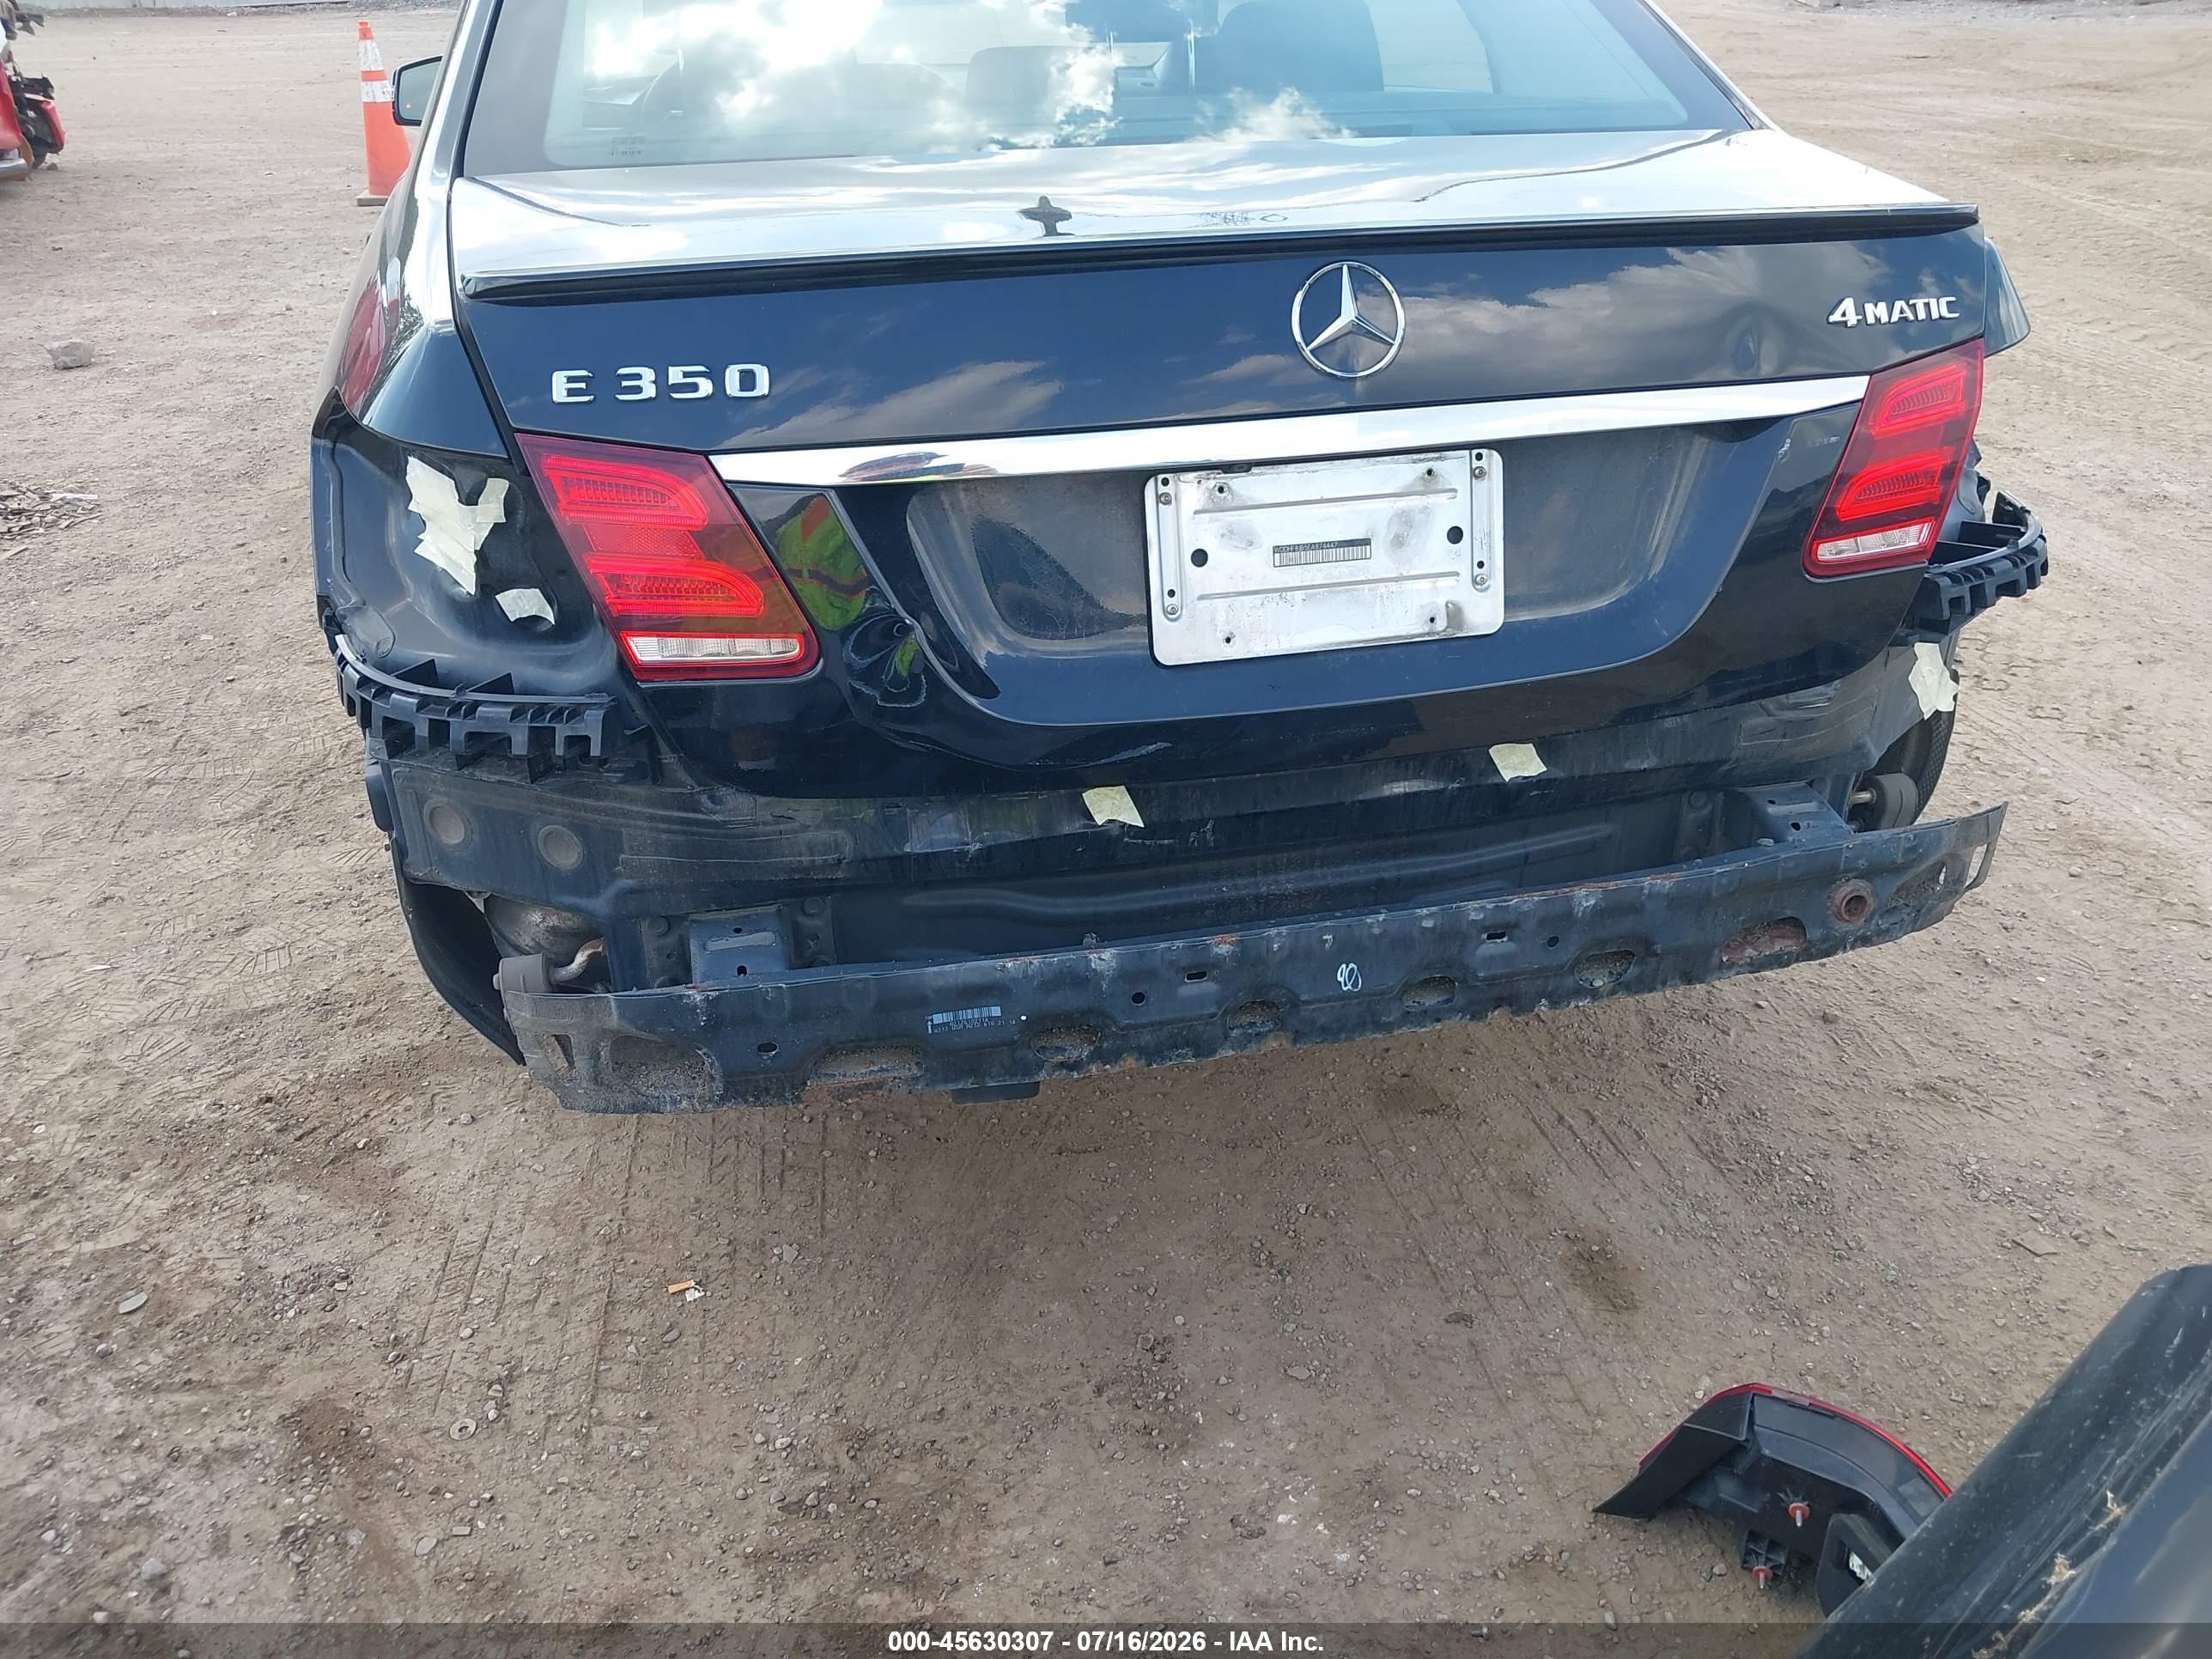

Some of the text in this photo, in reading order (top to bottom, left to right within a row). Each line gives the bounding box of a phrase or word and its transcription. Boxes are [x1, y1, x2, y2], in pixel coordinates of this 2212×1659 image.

[1828, 296, 1960, 328] 4MATIC
[551, 363, 770, 404] E 350
